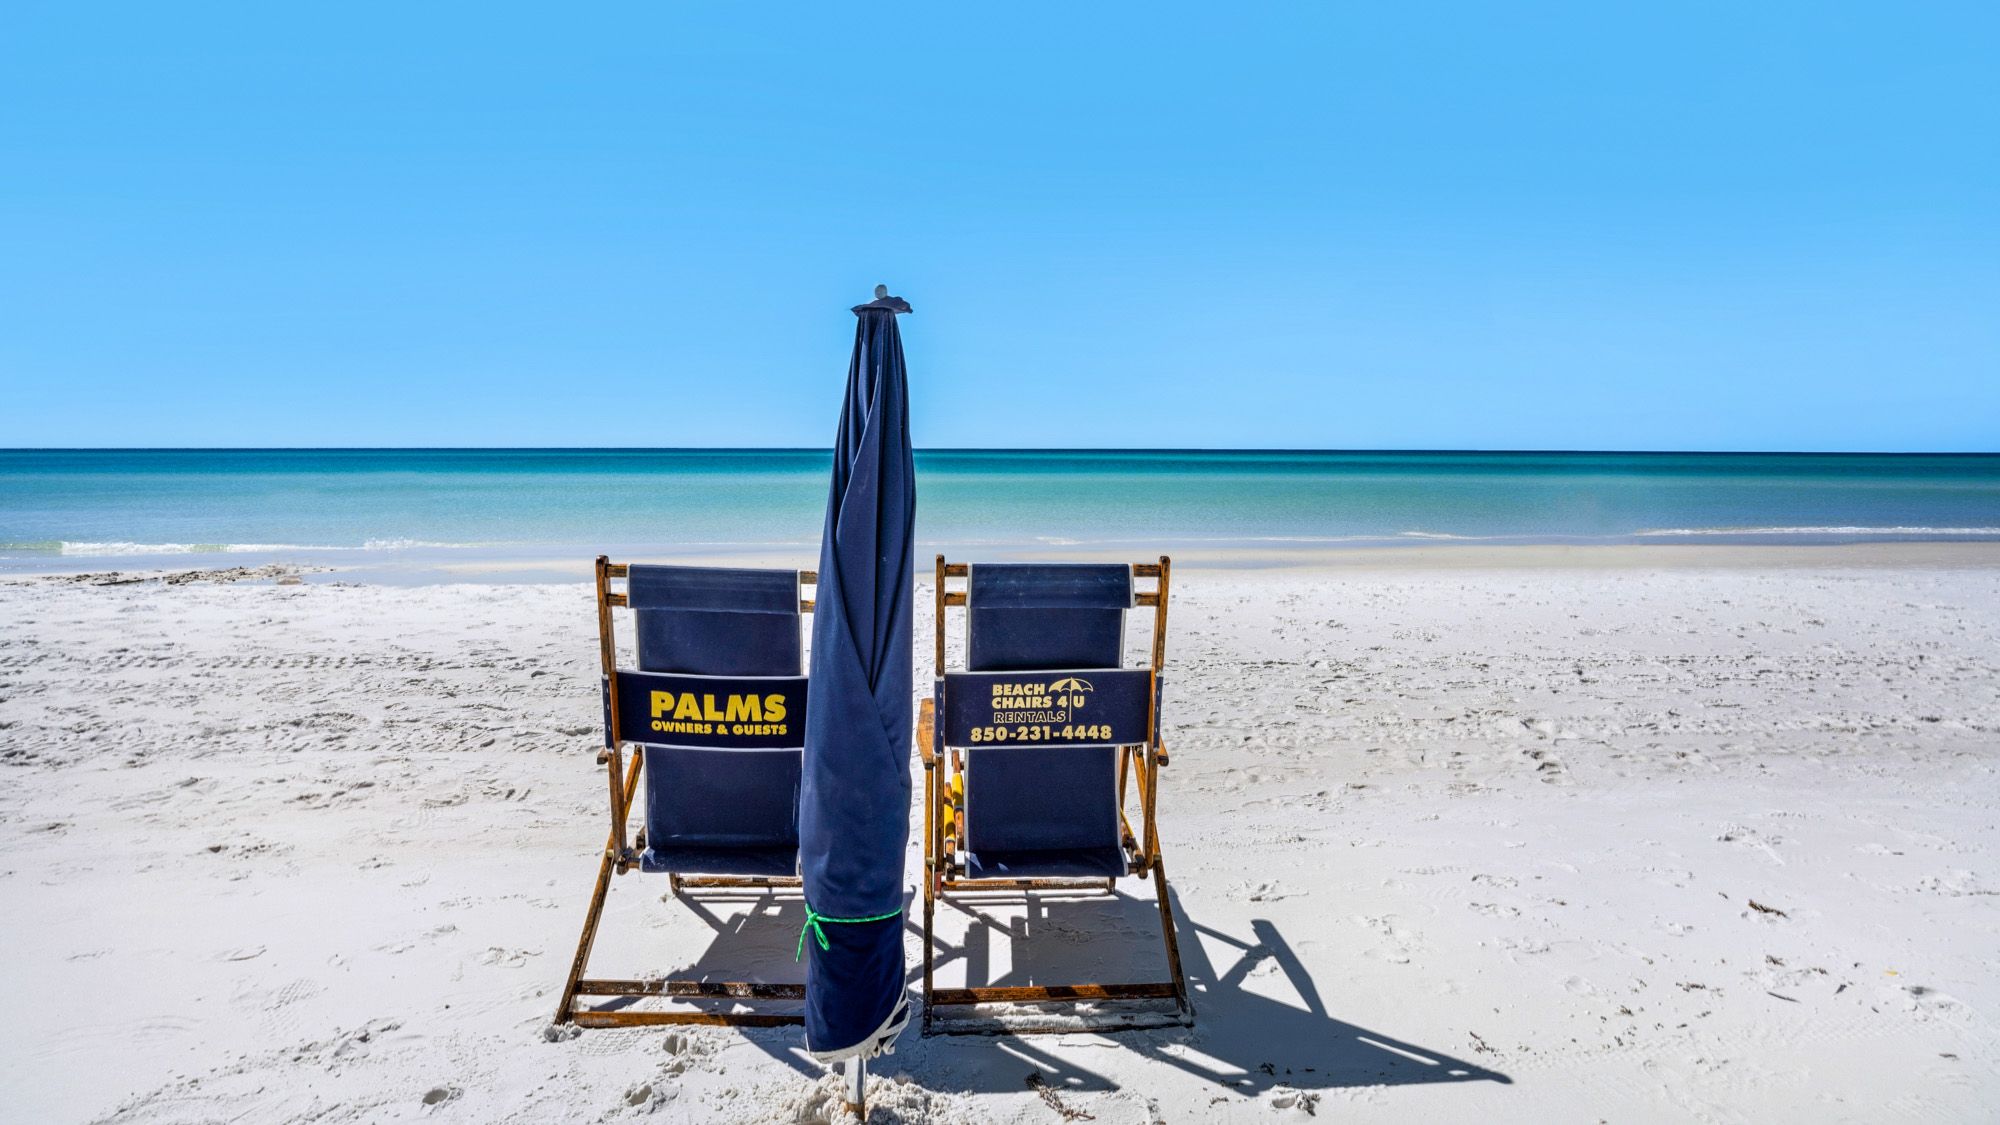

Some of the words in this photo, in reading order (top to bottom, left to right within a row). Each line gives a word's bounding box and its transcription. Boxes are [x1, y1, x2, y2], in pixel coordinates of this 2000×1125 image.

[992, 683, 1045, 696] BEACH
[650, 690, 787, 722] PALMS
[991, 696, 1052, 709] CHAIRS
[1056, 695, 1068, 708] 4
[1073, 695, 1085, 708] U
[993, 710, 1067, 724] RENTALS
[651, 720, 713, 735] OWNERS
[716, 723, 729, 735] &
[732, 724, 787, 736] GUESTS
[970, 725, 1112, 742] 850-231-4448
